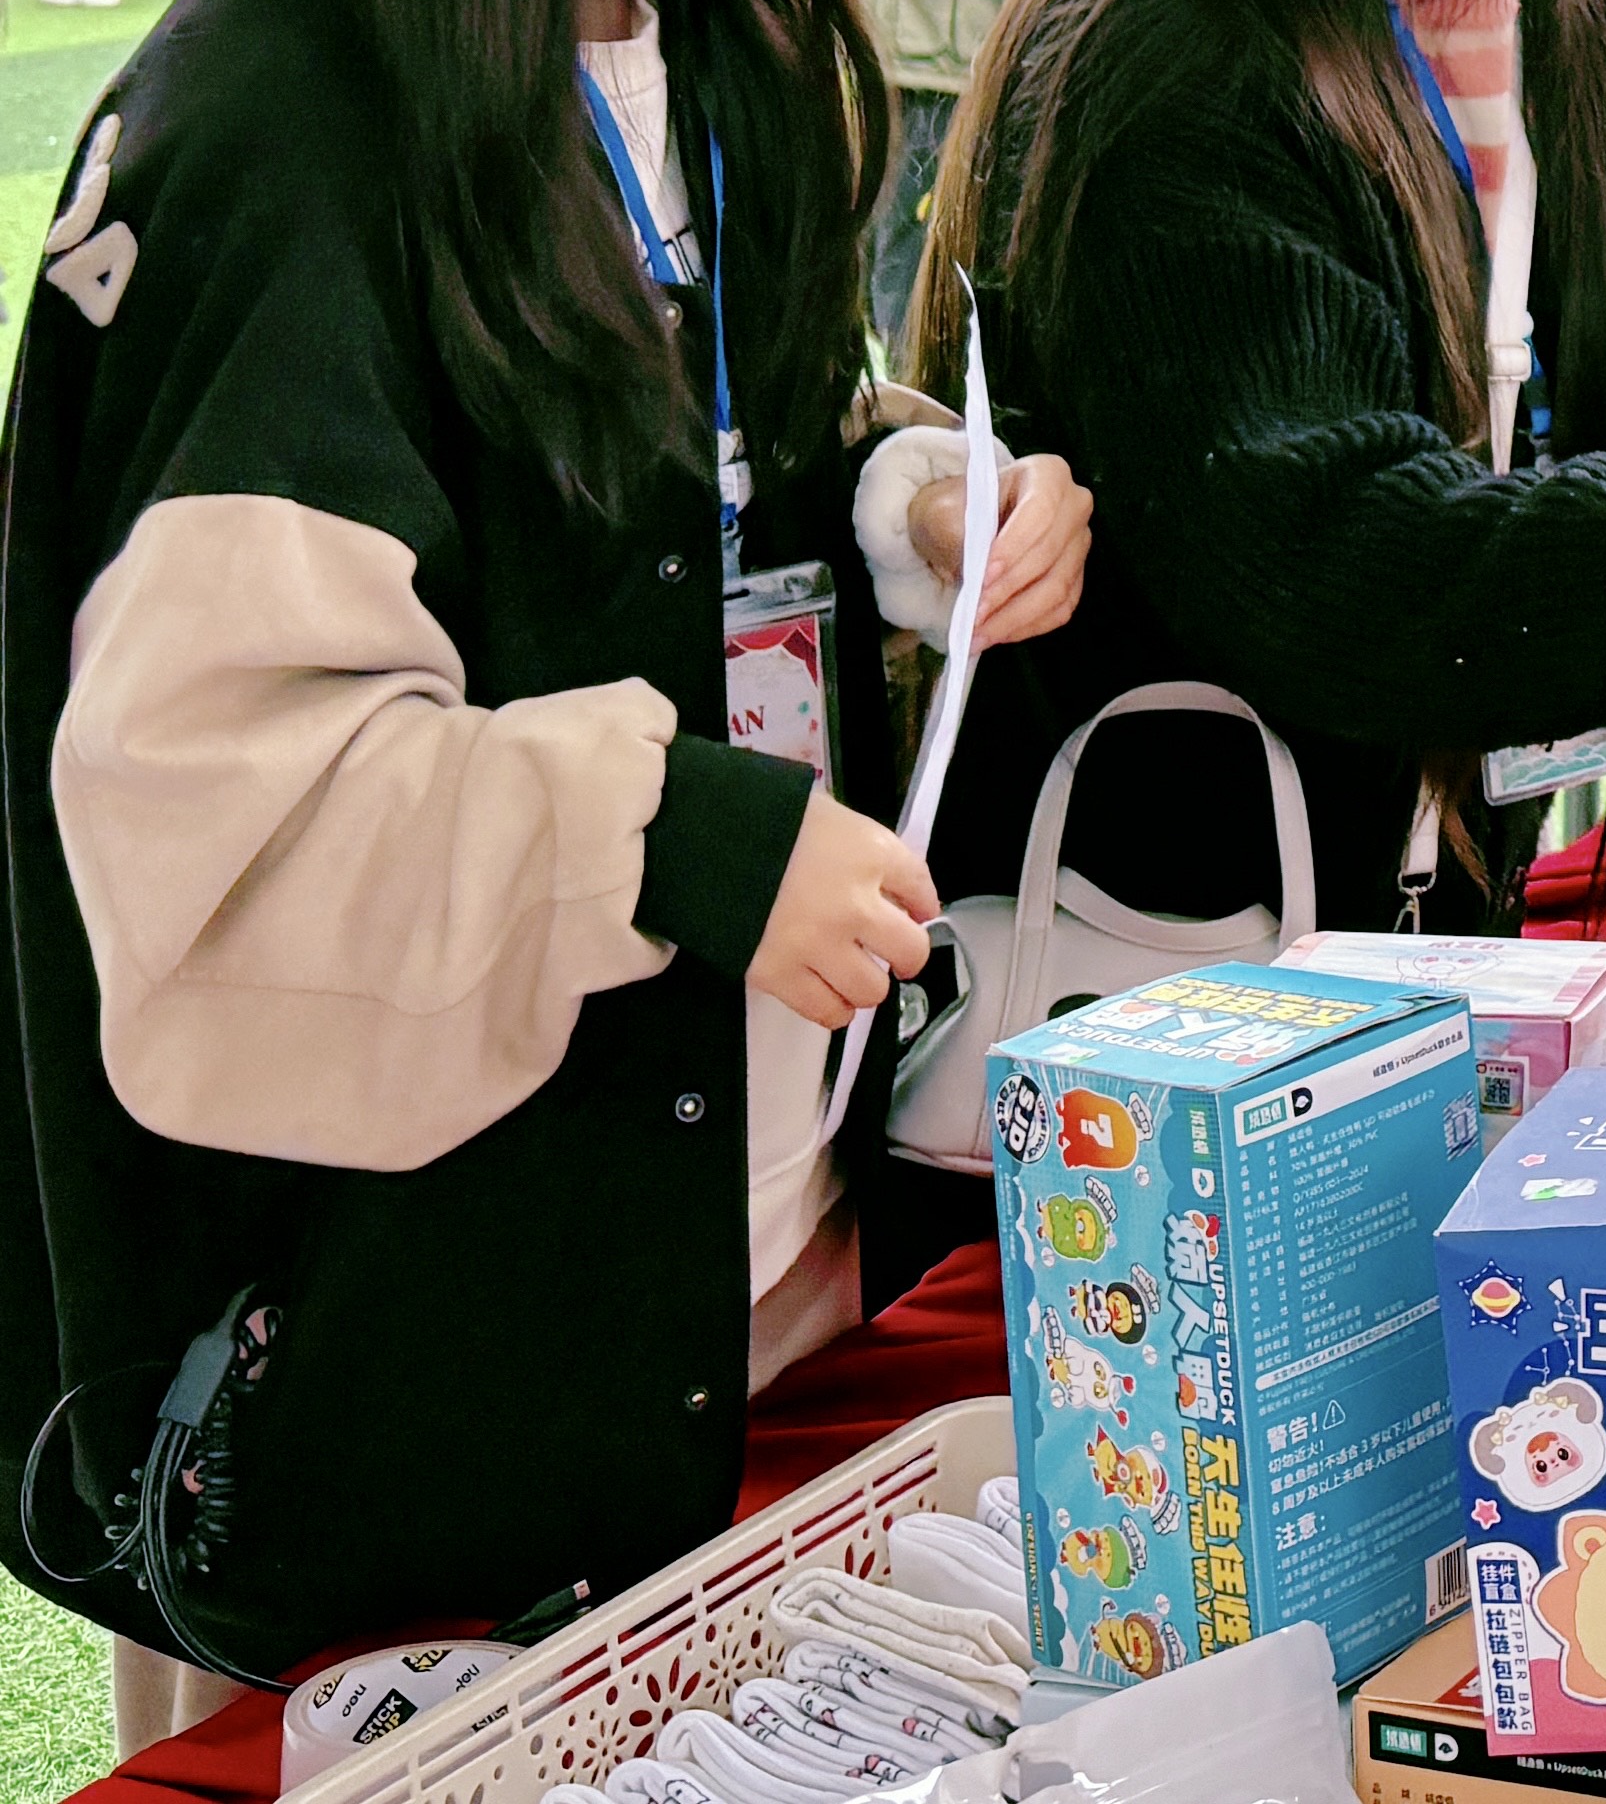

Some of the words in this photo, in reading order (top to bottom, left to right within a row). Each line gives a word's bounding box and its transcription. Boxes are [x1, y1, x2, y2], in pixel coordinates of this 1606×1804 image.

[1206, 1262, 1238, 1429] UPSETDUCK
[1481, 1562, 1517, 1583] 挂件
[1509, 1607, 1527, 1681] ZIPPER
[1518, 1691, 1533, 1731] BAG
